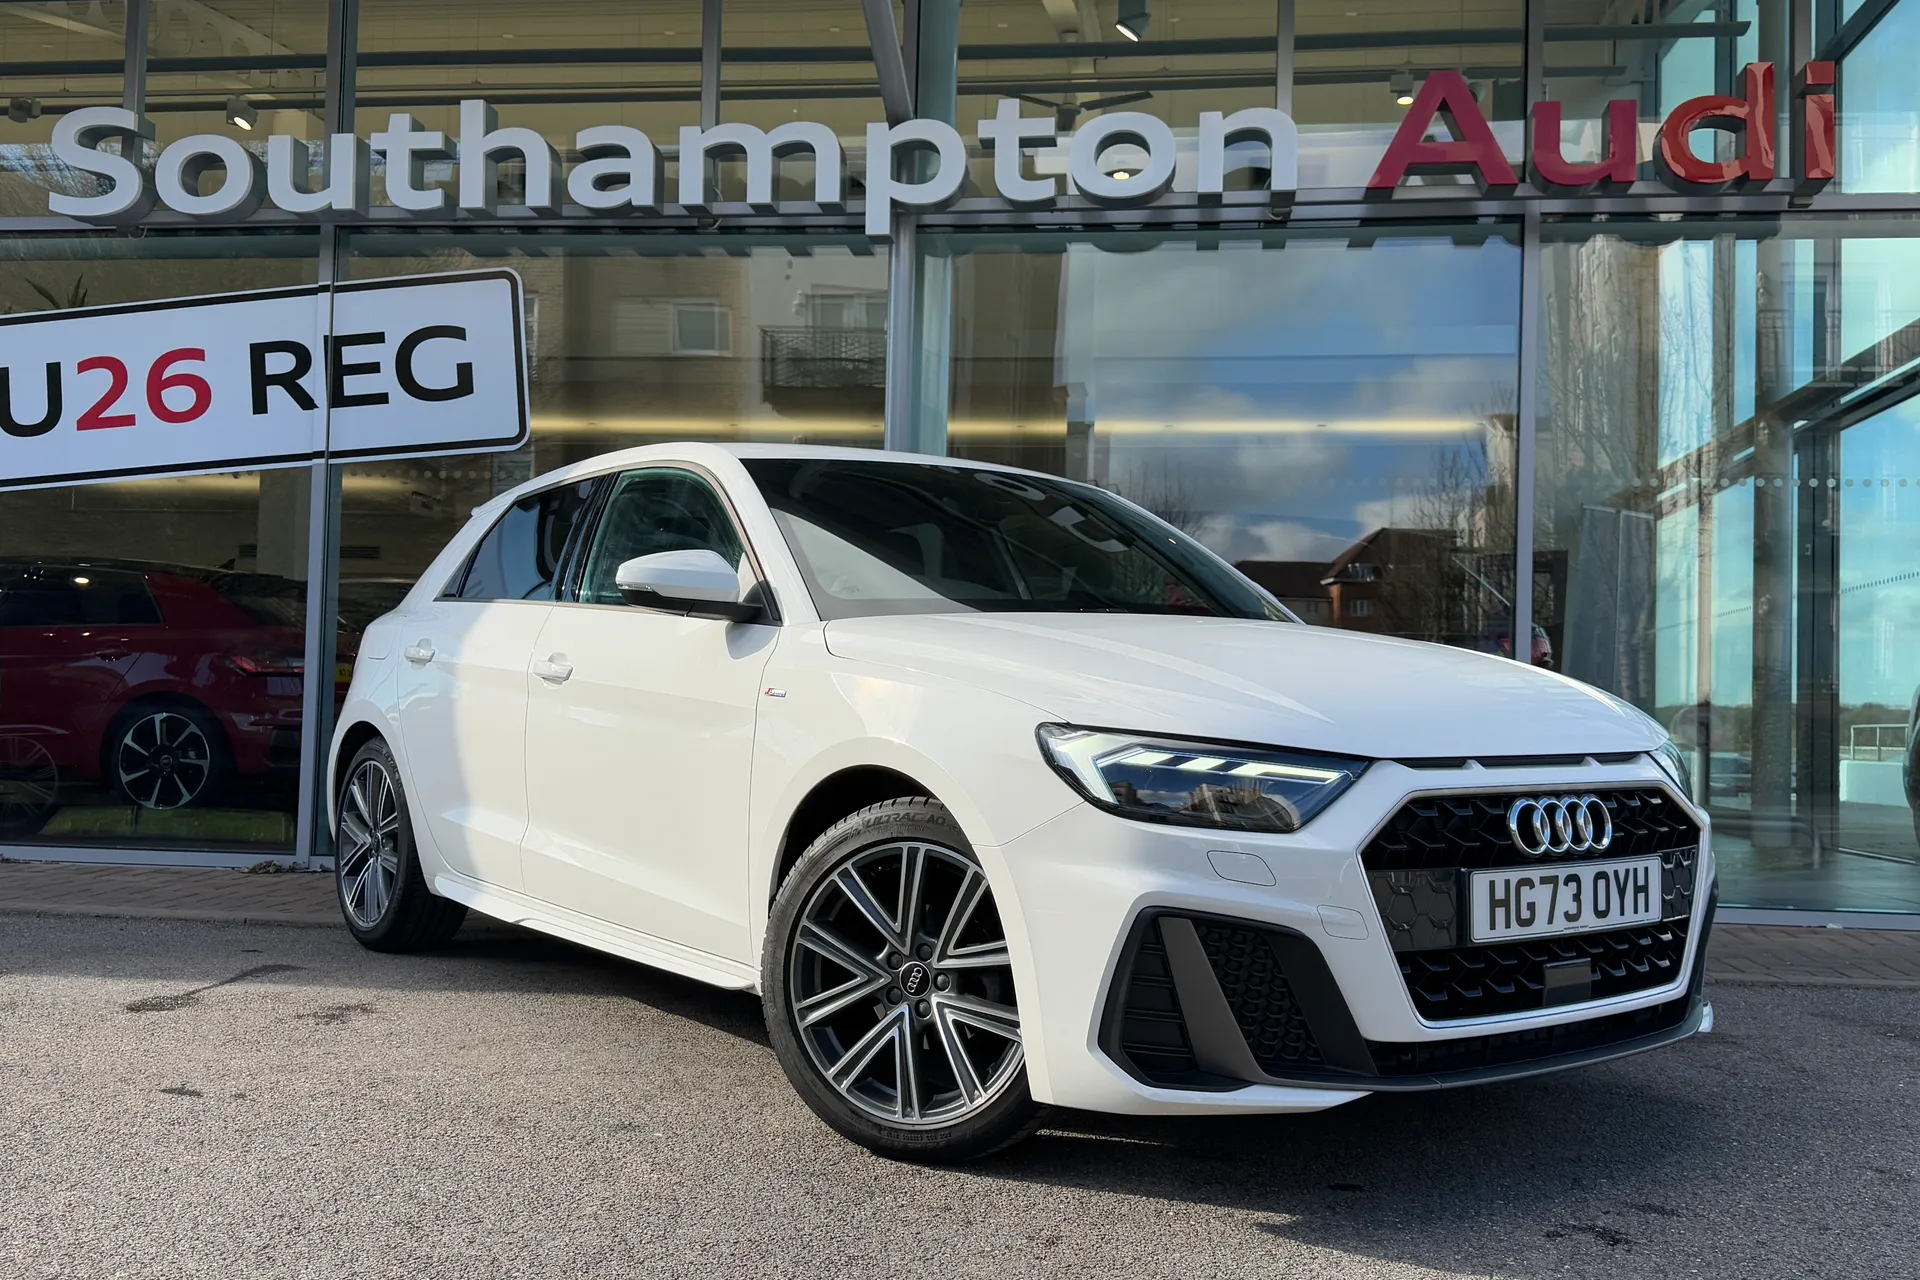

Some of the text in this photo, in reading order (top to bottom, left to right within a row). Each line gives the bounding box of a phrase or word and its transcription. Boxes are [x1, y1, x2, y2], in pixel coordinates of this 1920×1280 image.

[49, 61, 1836, 236] Southampton Audi
[249, 325, 474, 415] REG
[866, 812, 925, 828] ULTRAC
[1489, 866, 1650, 931] HG73 OYH
